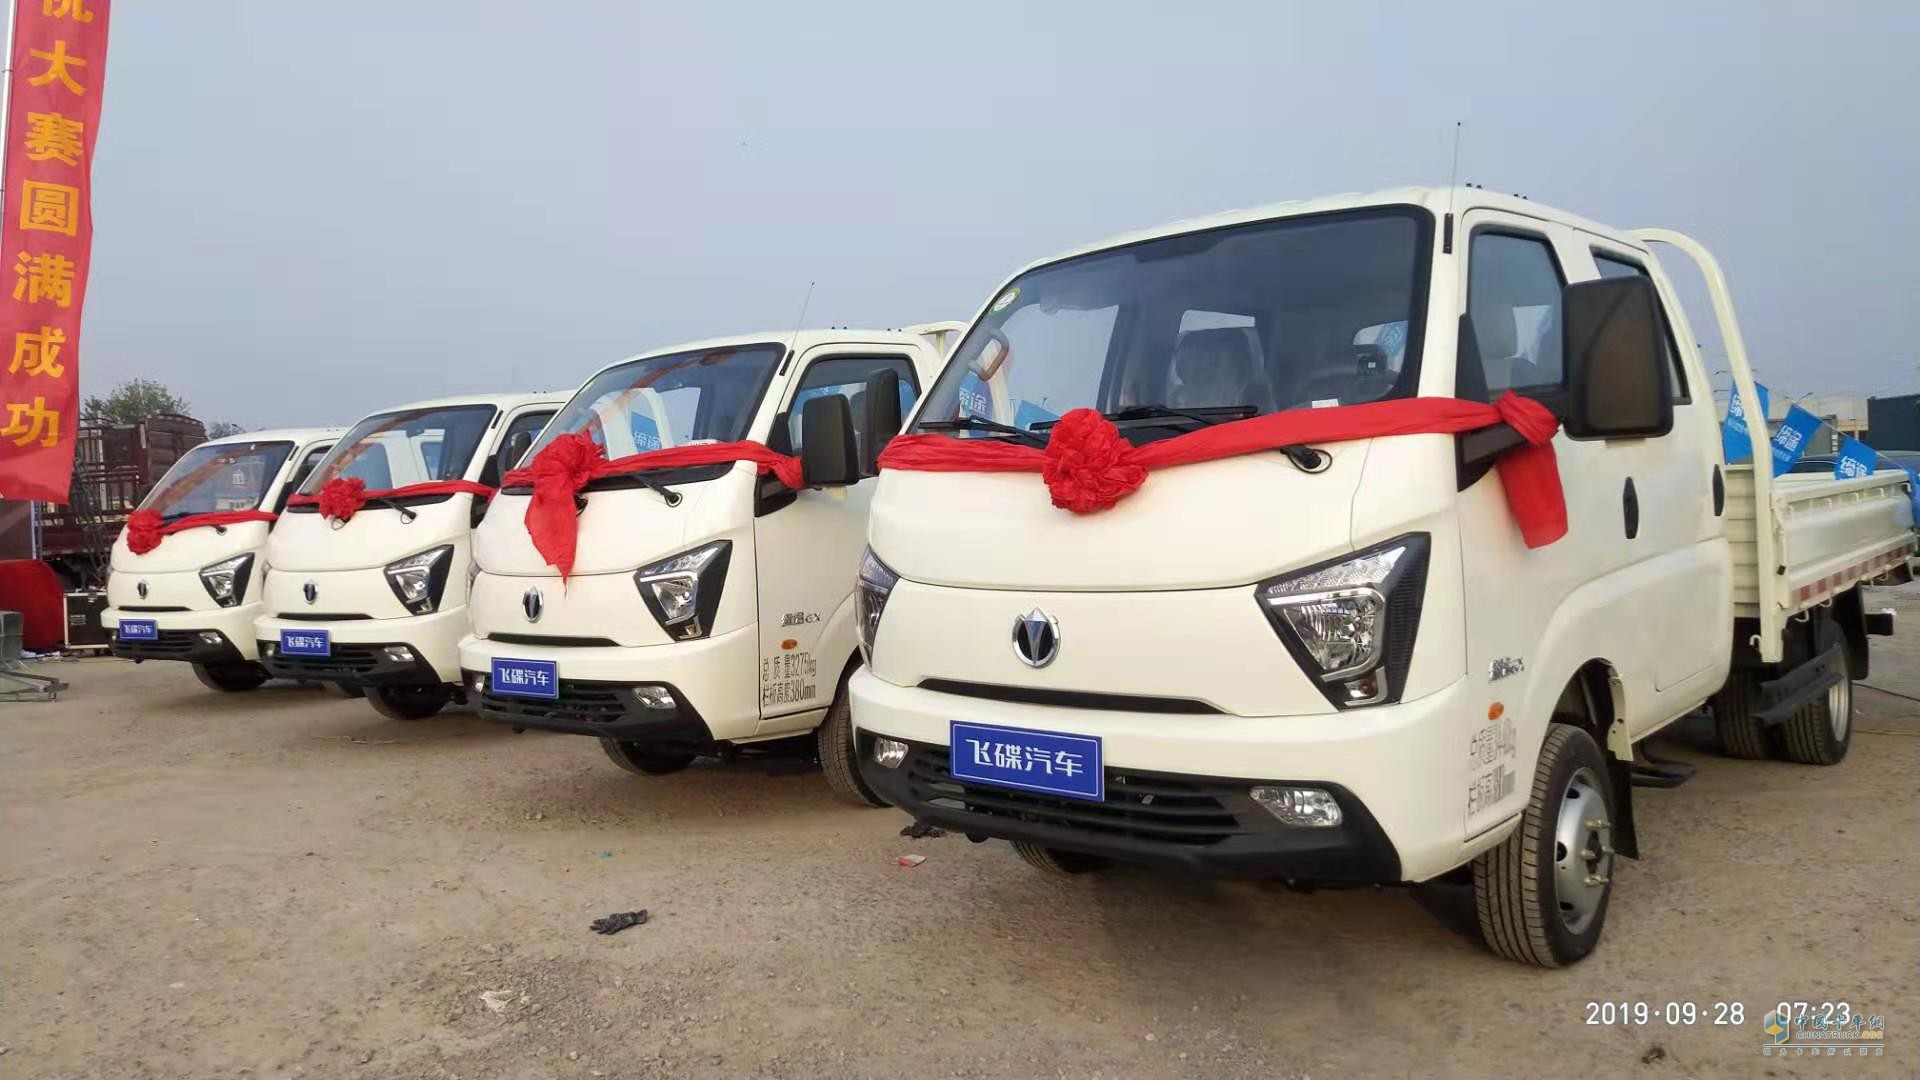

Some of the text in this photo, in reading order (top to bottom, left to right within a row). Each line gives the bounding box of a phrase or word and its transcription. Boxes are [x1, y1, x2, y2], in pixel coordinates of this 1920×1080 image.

[498, 667, 549, 686] 飞碟汽车
[965, 738, 1083, 777] 飞碟汽车
